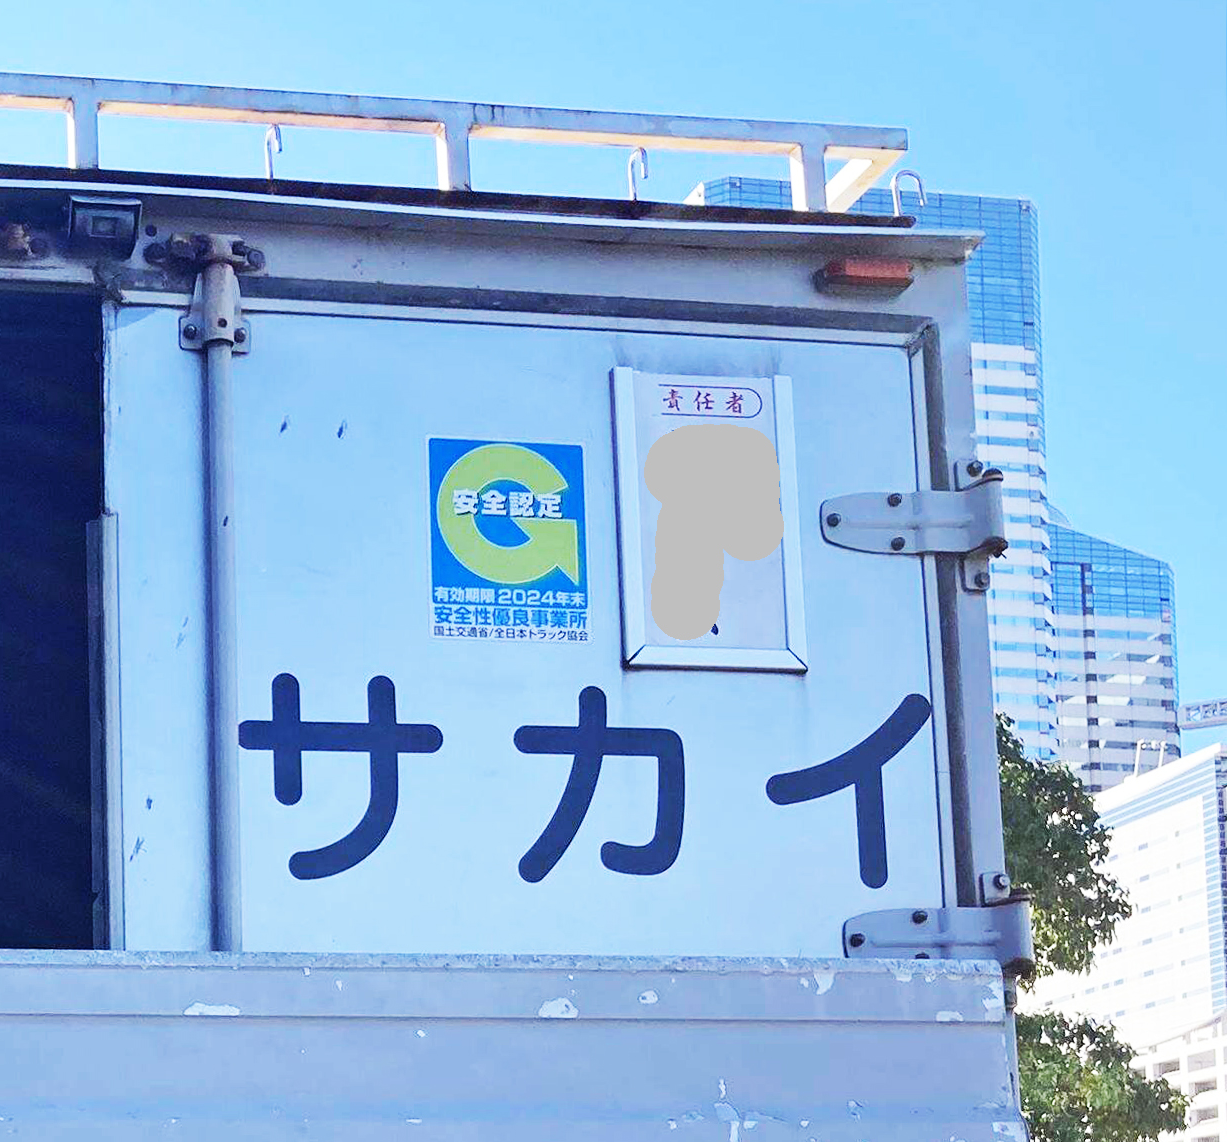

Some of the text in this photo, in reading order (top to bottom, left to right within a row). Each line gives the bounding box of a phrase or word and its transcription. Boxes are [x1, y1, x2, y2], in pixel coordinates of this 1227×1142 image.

[662, 388, 744, 414] 責任者
[452, 488, 563, 520] 安全認定
[433, 605, 588, 631] 安全性優良事業所
[239, 672, 933, 889] サカイ
